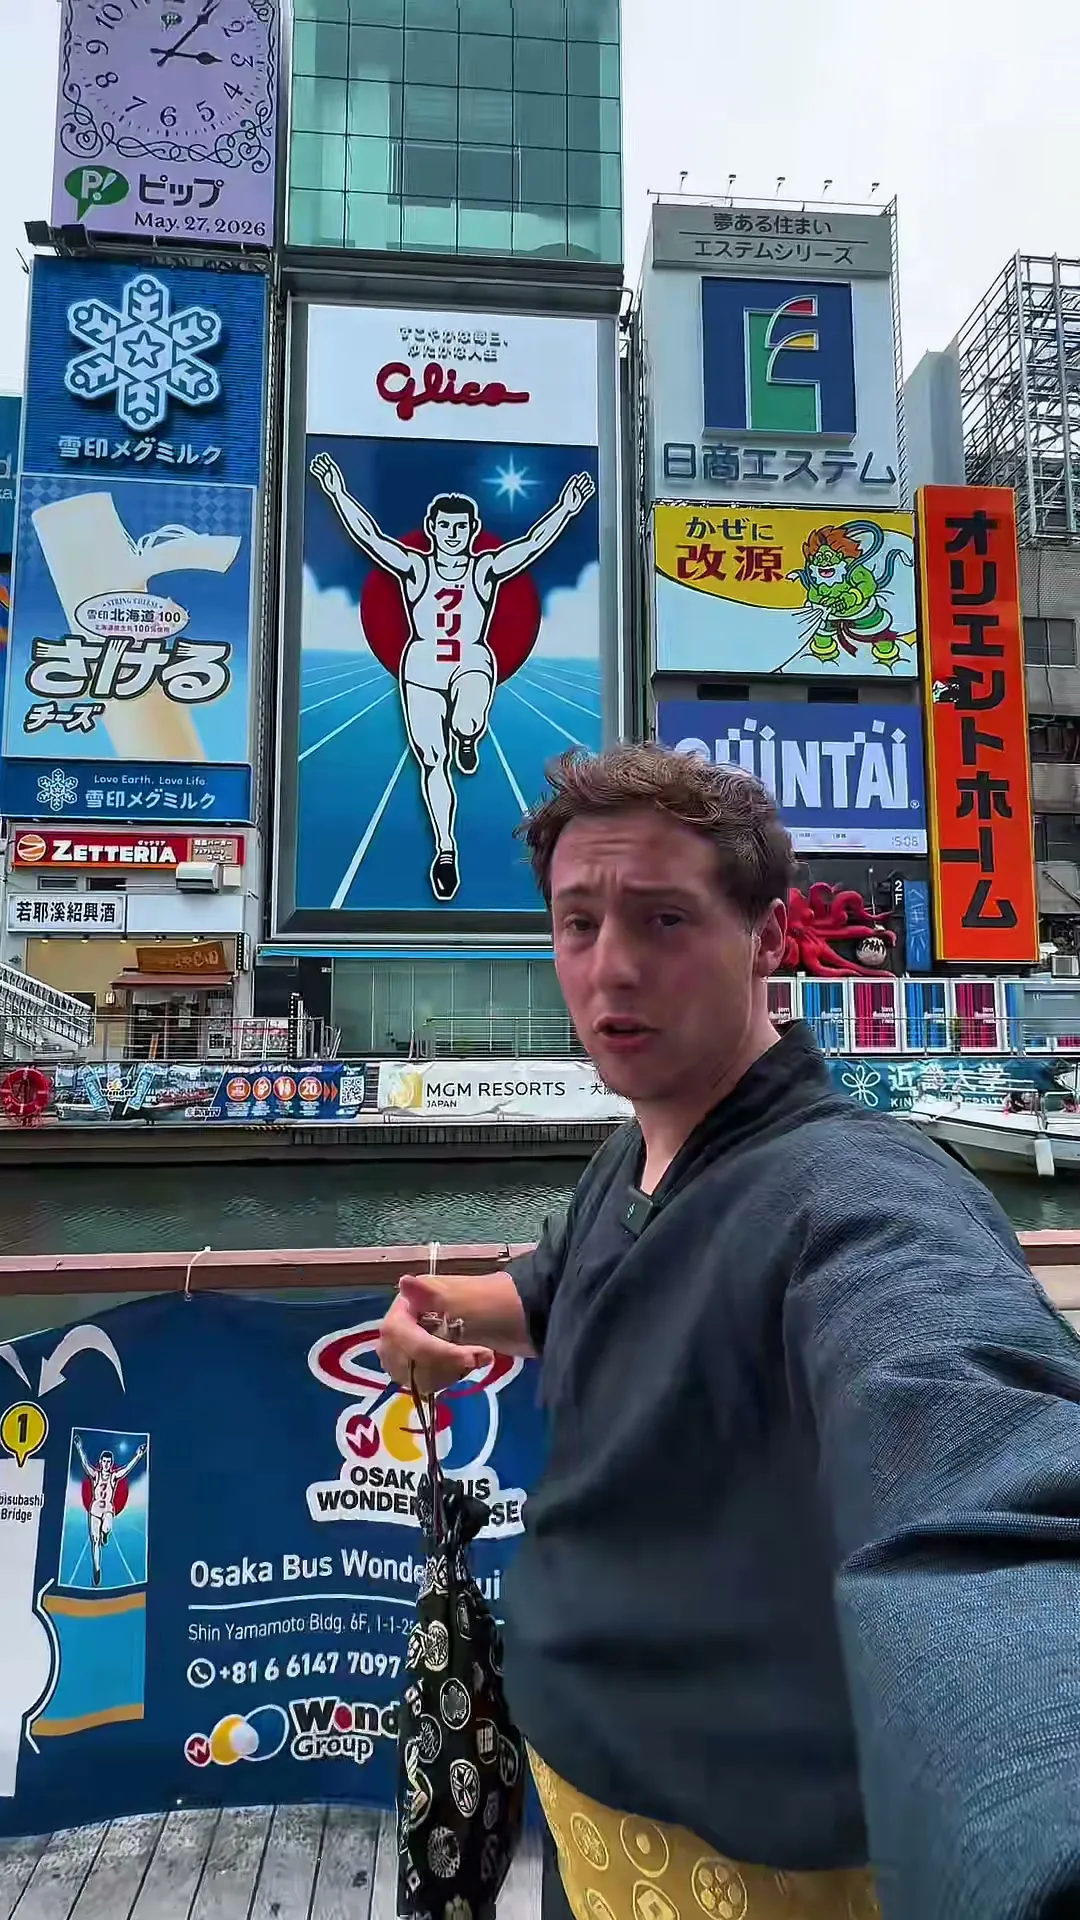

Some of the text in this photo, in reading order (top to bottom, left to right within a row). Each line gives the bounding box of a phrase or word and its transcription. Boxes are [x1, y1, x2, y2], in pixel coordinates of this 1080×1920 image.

[96, 3, 123, 30] 10
[223, 20, 245, 38] 2
[86, 39, 109, 55] 9
[231, 53, 254, 68] 3
[95, 71, 119, 89] 8
[223, 81, 243, 100] 4
[125, 95, 148, 112] 7
[196, 100, 215, 122] 5
[160, 106, 177, 127] 6
[138, 173, 225, 208] ピップ
[215, 219, 266, 237] 2026
[713, 212, 832, 235] 夢ある住まい
[695, 240, 854, 265] エステムシリーズ
[59, 435, 222, 466] 雪印メグミルク
[663, 443, 897, 485] 日商エステム
[685, 516, 774, 541] かぜに
[676, 543, 785, 583] 改源
[434, 584, 465, 662] グリコ
[25, 635, 231, 703] さける
[24, 701, 105, 733] チーズ
[941, 509, 1018, 929] オリエントホーム
[94, 775, 118, 785] Love
[159, 776, 183, 786] Love
[85, 788, 215, 810] 雪印メグミルク
[52, 840, 176, 863] ZETTERIA
[426, 1083, 472, 1097] MGM
[478, 1082, 566, 1096] RESORTS
[18, 1413, 28, 1443] 1
[1, 1509, 32, 1523] Bridge
[190, 1557, 273, 1588] Osaka
[283, 1553, 333, 1581] Bus
[188, 1622, 220, 1643] Shin
[226, 1616, 304, 1641] Yamamoto
[309, 1612, 346, 1633] Bldg.
[350, 1613, 370, 1634] 6F,
[219, 1650, 401, 1685] +81 6 6147 7097
[292, 1734, 374, 1763] Group
